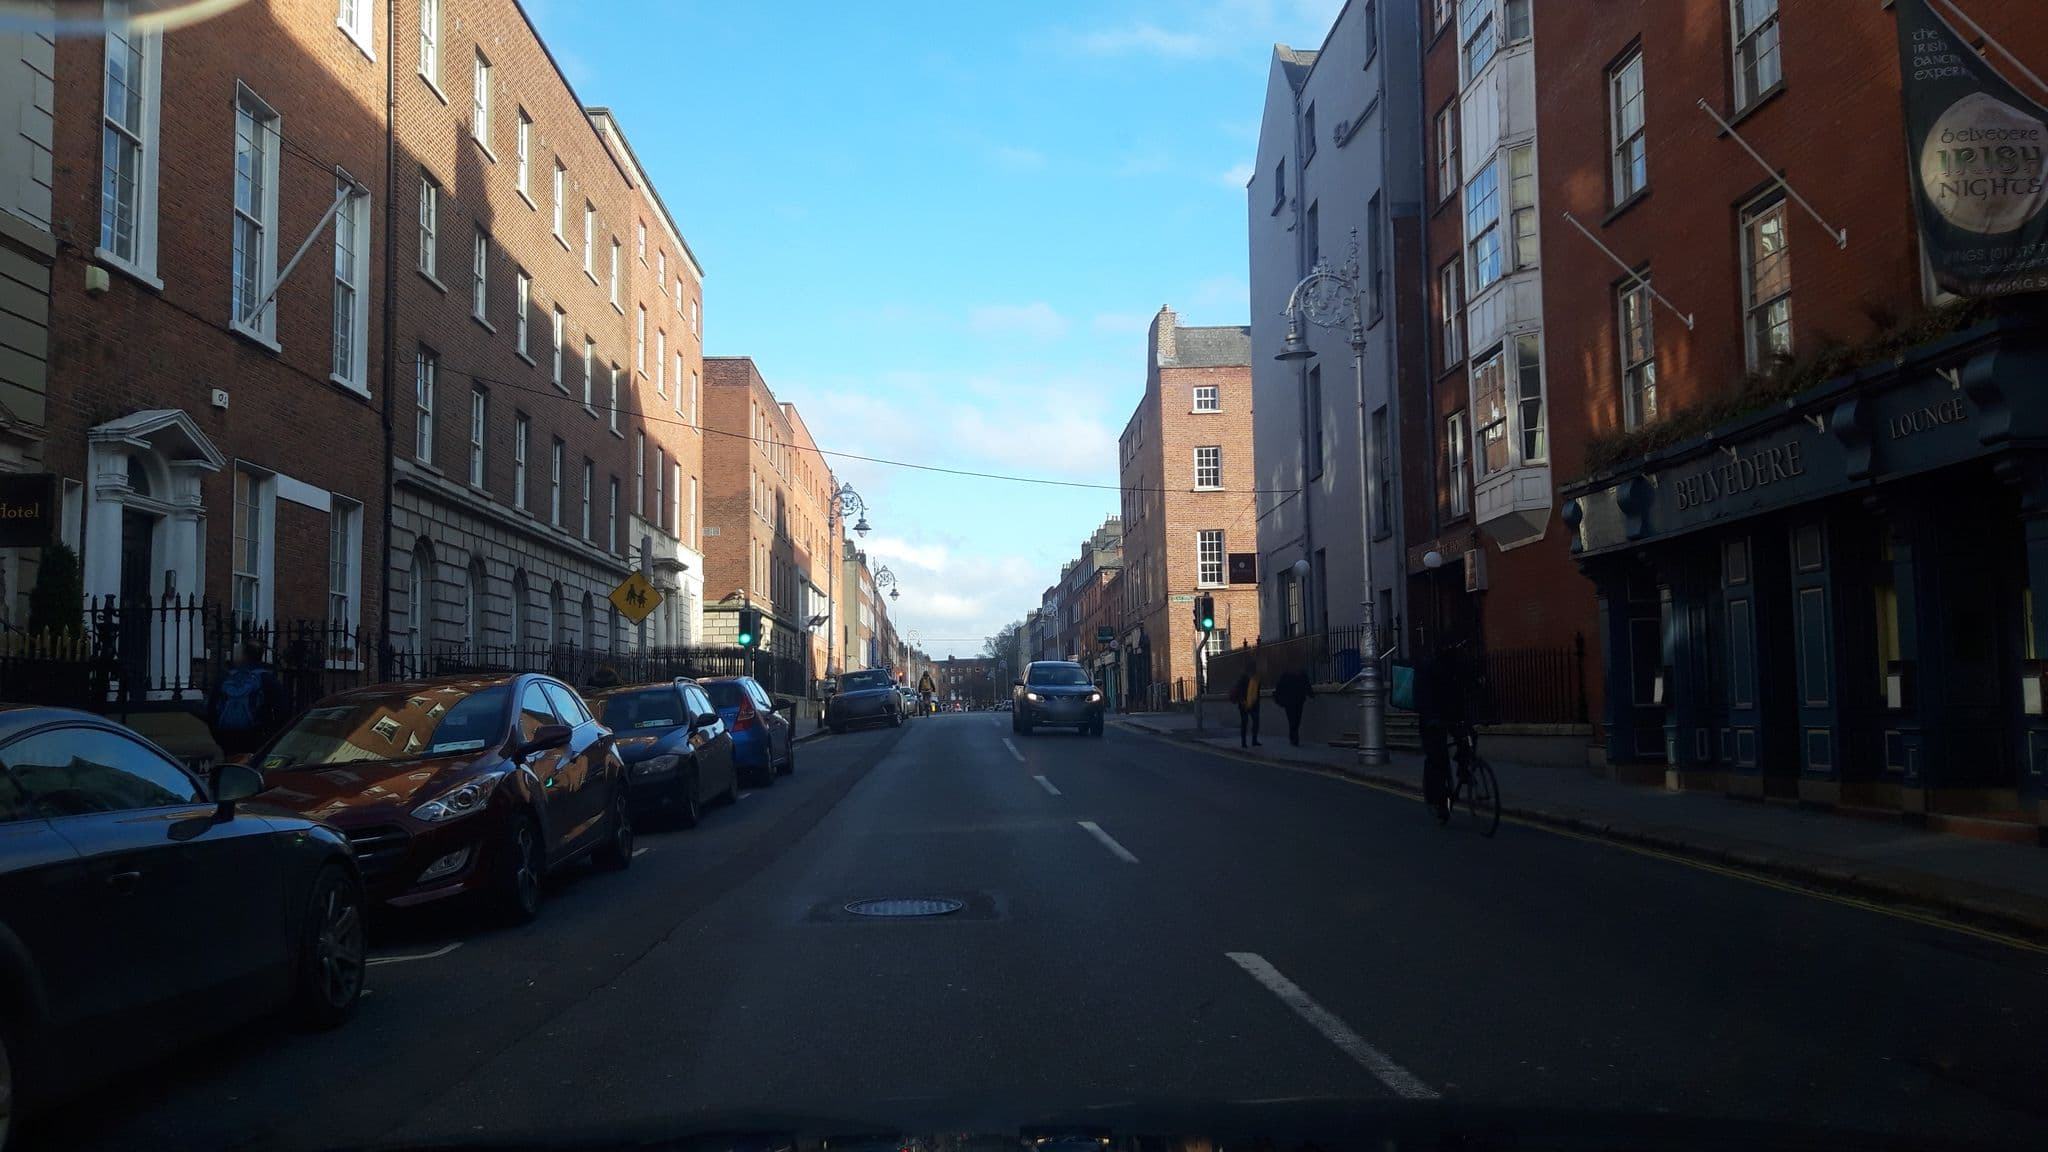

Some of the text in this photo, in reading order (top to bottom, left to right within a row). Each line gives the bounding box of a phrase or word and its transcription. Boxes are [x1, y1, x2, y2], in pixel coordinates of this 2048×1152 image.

[1937, 145, 2041, 176] IRISH
[1940, 176, 2042, 200] NIGHTS
[1889, 397, 1967, 441] LOUNGE
[1674, 441, 1804, 510] BELVEDERE
